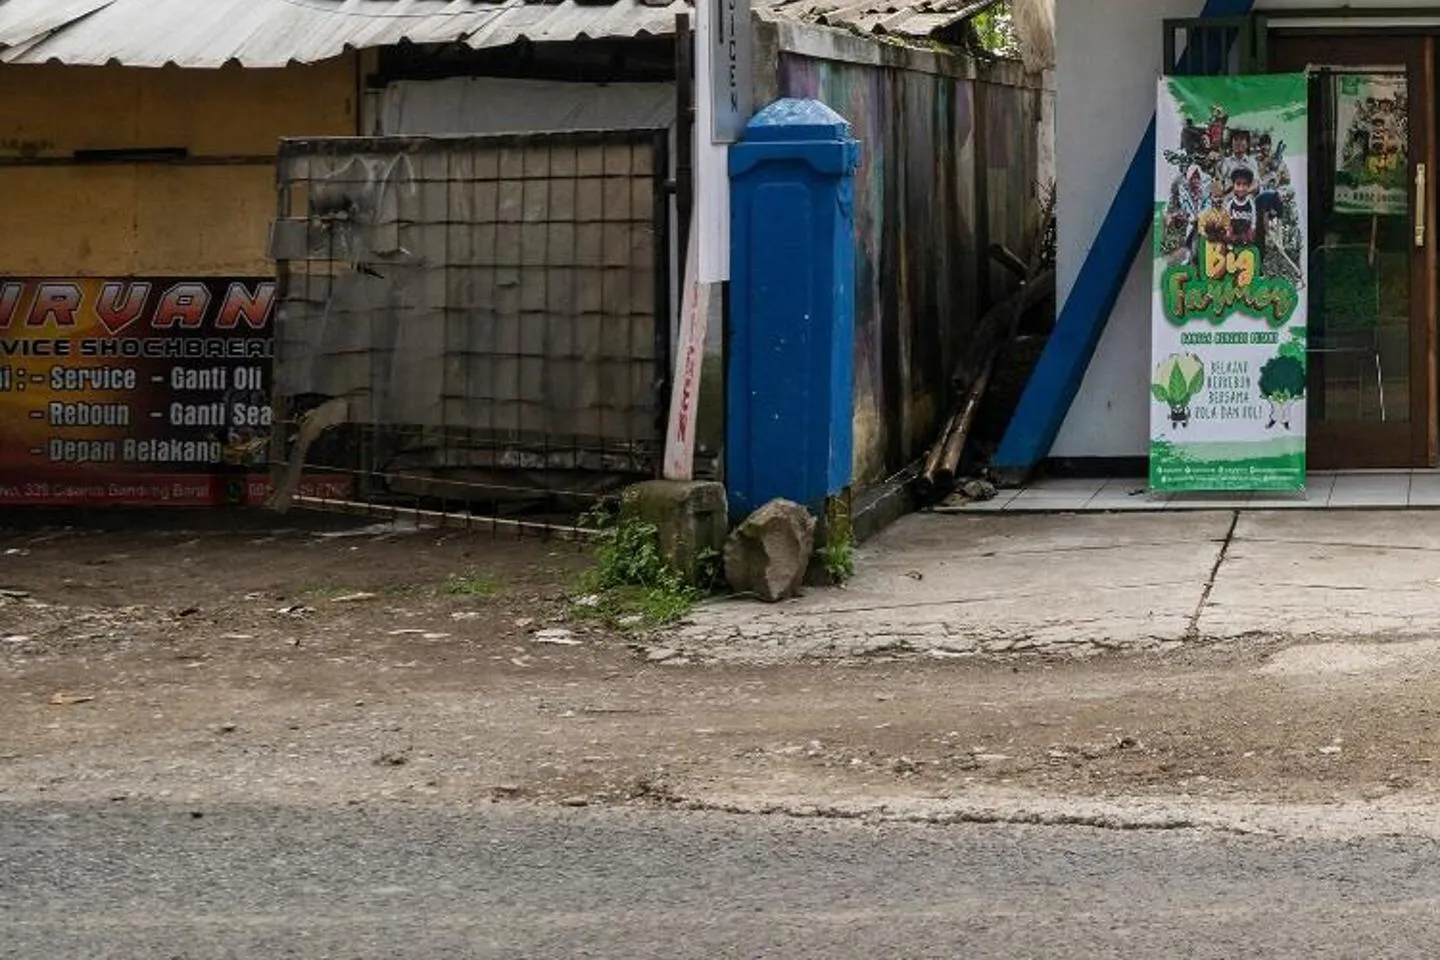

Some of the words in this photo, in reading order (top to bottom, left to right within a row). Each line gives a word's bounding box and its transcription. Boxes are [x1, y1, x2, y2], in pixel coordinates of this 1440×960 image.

[1205, 240, 1255, 287] Big
[51, 366, 136, 389] Service
[171, 366, 227, 390] Ganti
[233, 366, 262, 390] Oli
[51, 402, 129, 425] Reboun
[170, 402, 225, 425] Ganti
[51, 440, 115, 464] Depan
[124, 440, 222, 463] Belakang
